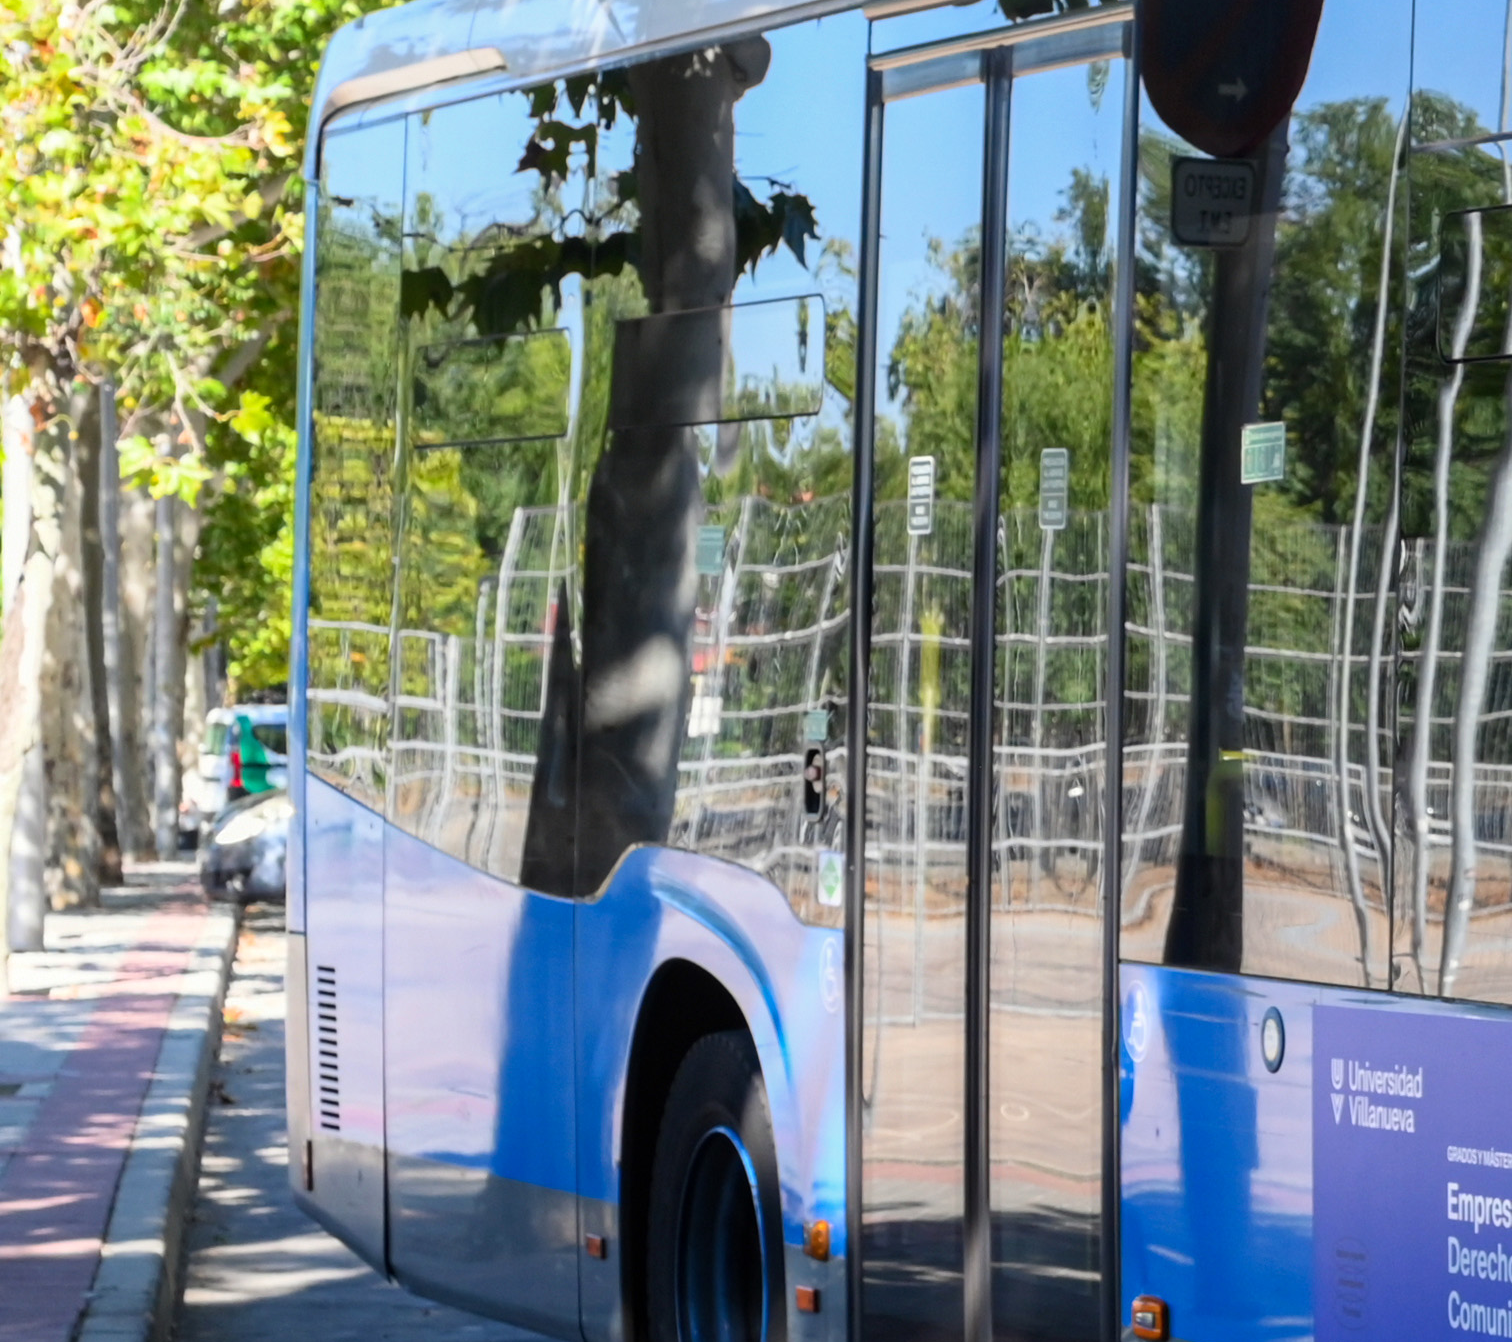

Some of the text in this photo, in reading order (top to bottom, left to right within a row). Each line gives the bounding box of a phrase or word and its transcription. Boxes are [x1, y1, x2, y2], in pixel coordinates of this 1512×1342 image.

[1348, 1060, 1423, 1099] Universidad
[1348, 1095, 1416, 1133] Villanueva
[1447, 1145, 1477, 1165] GRADOS
